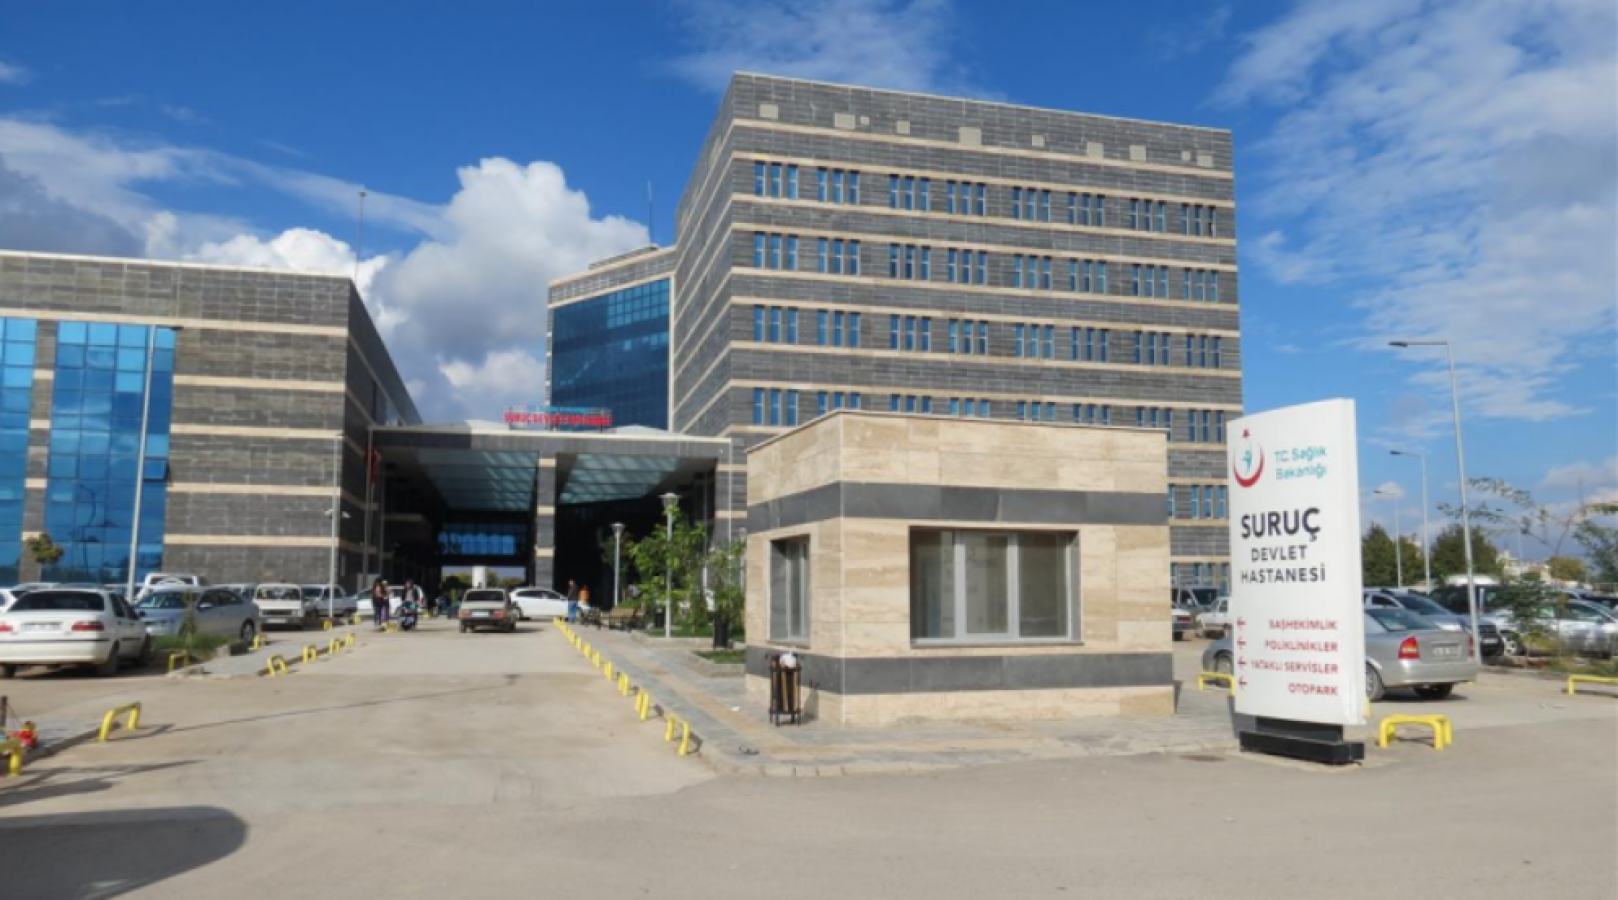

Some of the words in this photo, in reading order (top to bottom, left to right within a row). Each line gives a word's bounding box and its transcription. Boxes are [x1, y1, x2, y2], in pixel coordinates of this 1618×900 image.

[1292, 446, 1326, 462] Sağlık
[1241, 507, 1321, 542] SURUÇ
[1252, 545, 1307, 562] DEVLET
[1241, 563, 1326, 584] HASTANESİ
[1269, 617, 1337, 631] BAŞHEKİMLİK
[1265, 639, 1338, 652] POLİKLİNİKLER
[1284, 661, 1338, 674] SERVİSLER
[1288, 682, 1338, 695] OTOPARK
